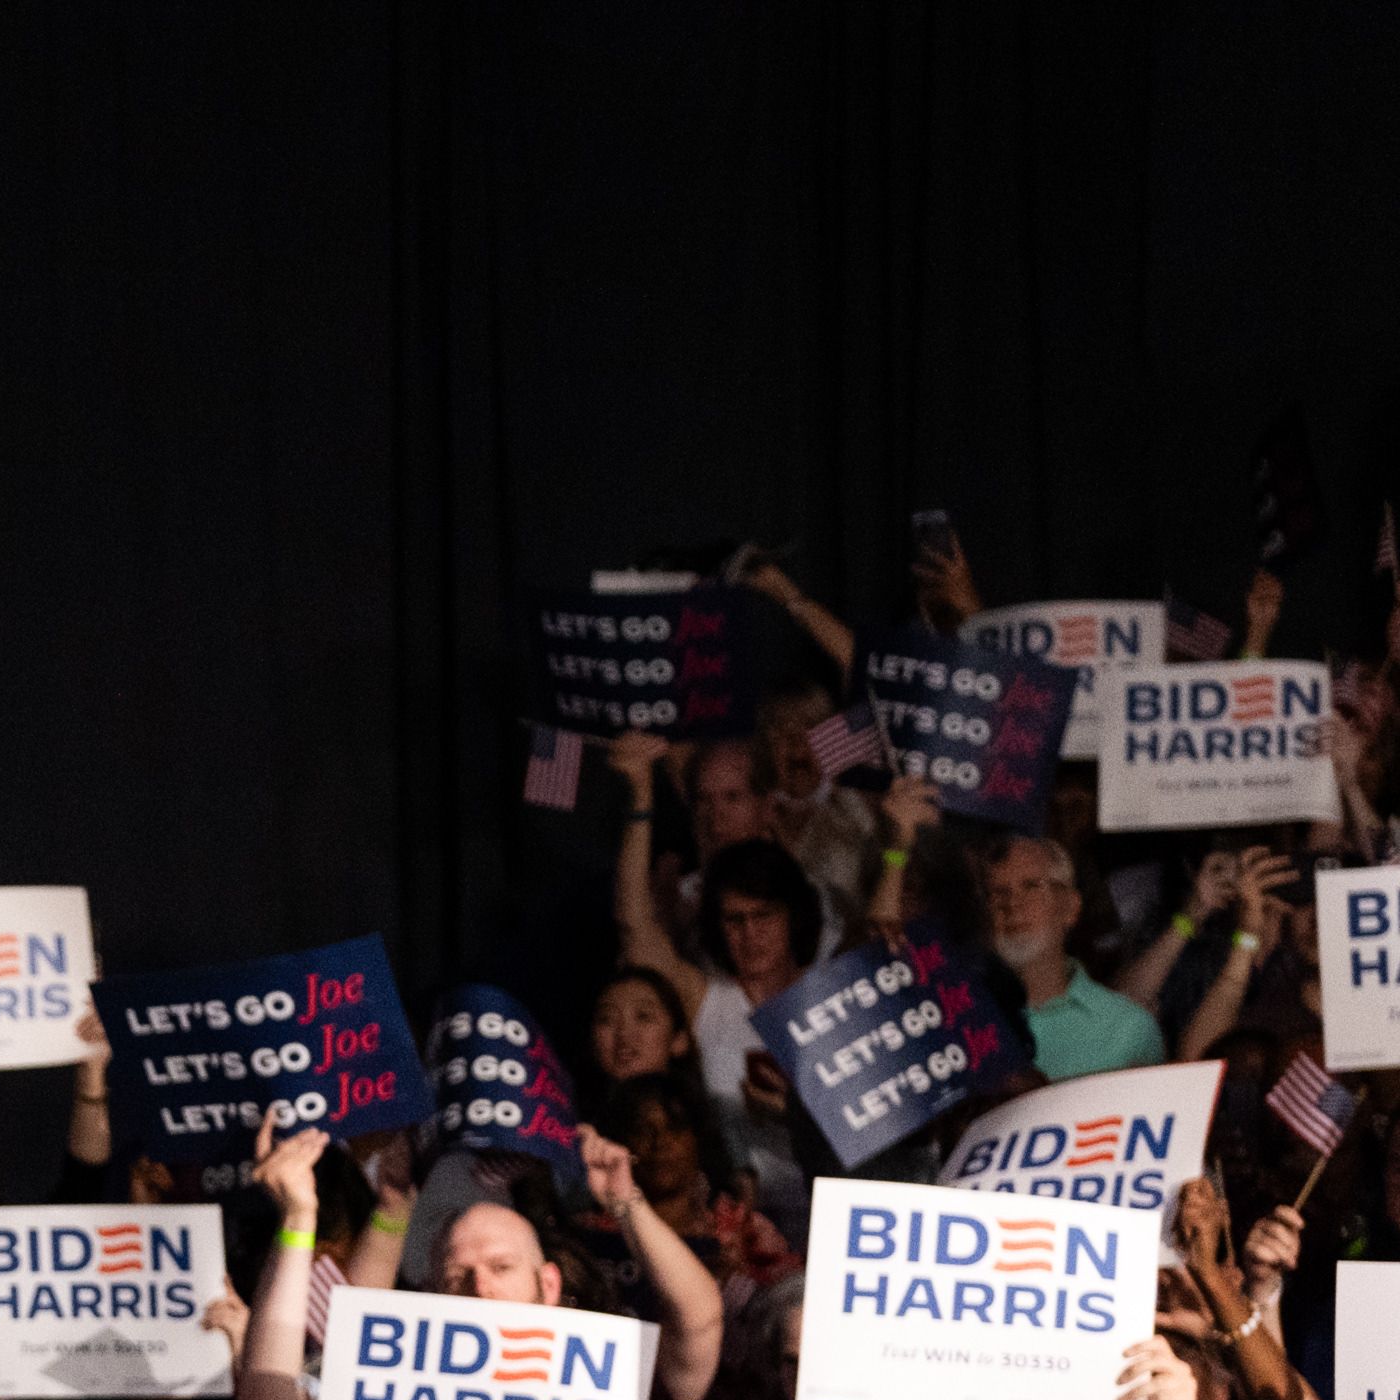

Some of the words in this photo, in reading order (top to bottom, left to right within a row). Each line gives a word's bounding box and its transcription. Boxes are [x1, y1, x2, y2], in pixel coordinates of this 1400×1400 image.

[620, 614, 671, 643] GO
[623, 657, 676, 687] GO
[951, 668, 1003, 702] GO
[1125, 675, 1322, 724] BIDEN
[940, 711, 991, 746] GO
[1125, 725, 1324, 765] HARRIS
[929, 756, 981, 791] GO
[126, 998, 232, 1037] LET'S
[234, 989, 296, 1027] GO
[299, 972, 365, 1025] Joe
[788, 972, 878, 1048] LET'S
[874, 960, 914, 997] GO
[144, 1048, 247, 1087] LET'S
[251, 1041, 311, 1079] GO
[315, 1021, 382, 1075] Joe
[476, 1011, 531, 1048] GO
[815, 1013, 900, 1090] LET'S
[900, 1000, 944, 1040] GO
[470, 1053, 528, 1087] GO
[842, 1057, 931, 1133] LET'S
[927, 1042, 968, 1083] GO
[161, 1100, 264, 1137] LET'S
[330, 1070, 398, 1123] Joe
[465, 1097, 524, 1129] GO
[957, 1113, 1176, 1178] BIDEN
[845, 1205, 1119, 1281] BIDEN
[841, 1272, 1117, 1334] HARRIS
[357, 1312, 618, 1392] BIDEN
[923, 1346, 971, 1366] WIN
[1000, 1353, 1073, 1373] 30330
